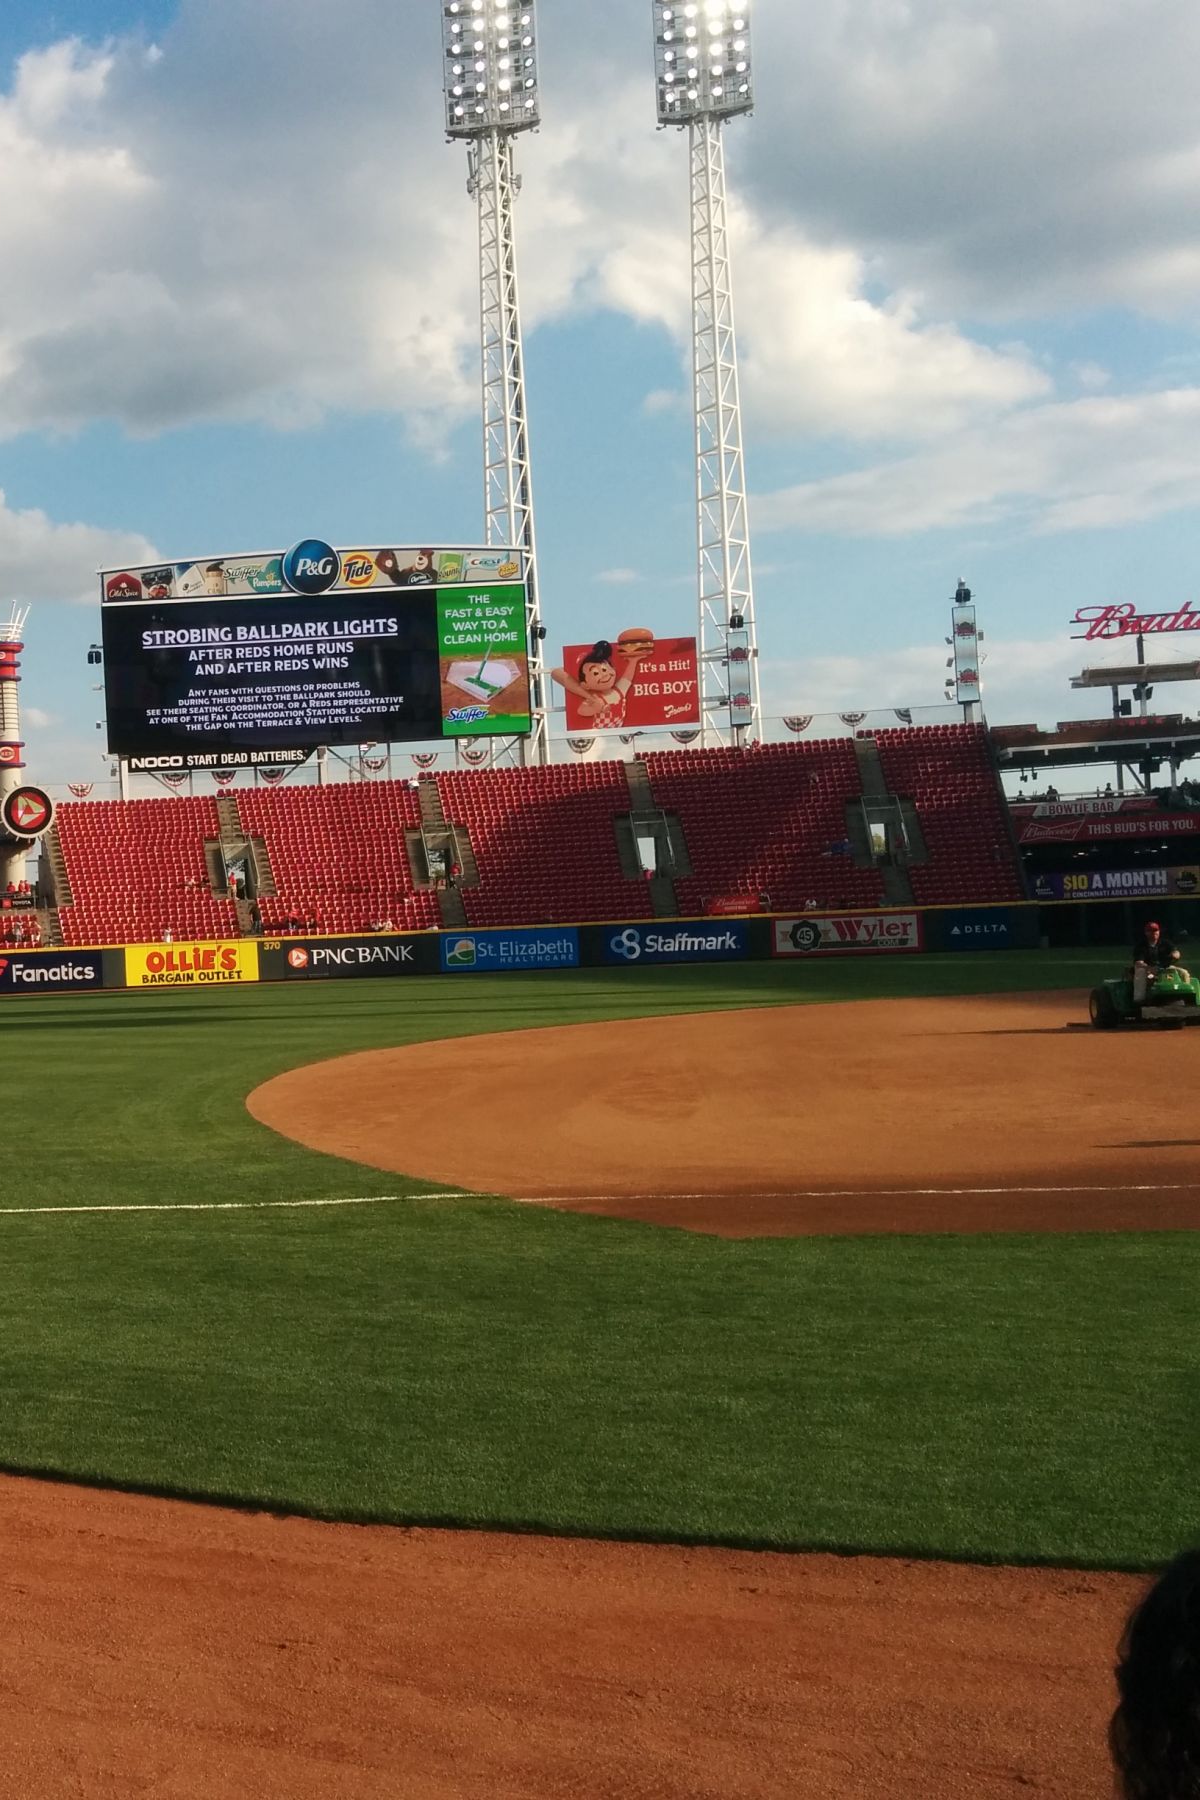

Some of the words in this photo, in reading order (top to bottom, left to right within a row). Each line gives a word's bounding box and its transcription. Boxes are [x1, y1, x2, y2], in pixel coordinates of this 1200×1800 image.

[223, 567, 261, 582] Swiffer
[295, 558, 333, 577] P&G
[344, 561, 373, 582] Tide
[252, 578, 282, 588] Pampers
[468, 594, 490, 604] THE
[445, 608, 473, 619] FAST
[474, 607, 483, 617] &
[485, 606, 514, 617] EASY
[142, 627, 233, 646] STROBING
[236, 621, 329, 641] BALLPARK
[333, 618, 398, 635] LIGHTS
[452, 621, 479, 632] WAY
[481, 620, 497, 630] TO
[499, 619, 509, 629] A
[444, 634, 481, 645] CLEAN
[484, 632, 518, 642] HOME
[189, 649, 232, 662] AFTER
[236, 646, 271, 659] REDS
[273, 644, 313, 657] HOME
[318, 642, 354, 654] RUNS
[195, 663, 224, 676] AND
[228, 661, 271, 674] AFTER
[274, 659, 309, 672] REDS
[312, 657, 349, 670] WINS
[639, 662, 657, 673] It's
[659, 664, 666, 672] a
[668, 659, 690, 671] Hit!
[208, 688, 230, 696] FANS
[231, 687, 254, 695] WITH
[255, 685, 301, 694] QUESTIONS
[316, 681, 360, 690] PROBLEMS
[634, 683, 660, 697] BIG
[662, 680, 693, 695] BOY
[163, 707, 188, 715] THEIR
[189, 705, 224, 714] SEATING
[333, 696, 404, 706] REPRESENTATIVE
[178, 698, 210, 706] DURING
[211, 696, 236, 704] THEIR
[238, 695, 259, 703] VISIT
[274, 693, 291, 701] THE
[293, 691, 335, 700] BALLPARK
[337, 690, 370, 698] SHOULD
[161, 716, 178, 724] ONE
[180, 715, 191, 723] OF
[350, 706, 388, 714] LOCATED
[446, 706, 490, 723] Swiffer
[223, 721, 236, 729] ON
[295, 717, 302, 726] &
[131, 756, 183, 769] NOCO
[187, 753, 219, 766] START
[221, 752, 247, 764] DEAD
[250, 749, 307, 763] BATTERIES.
[1049, 802, 1090, 815] BOWTIE
[1092, 801, 1115, 813] BAR
[1088, 824, 1112, 835] THIS
[1115, 822, 1147, 834] BUD'S
[1150, 821, 1170, 831] FOR
[1172, 819, 1197, 830] YOU.
[1063, 873, 1088, 891] $10
[1092, 873, 1103, 889] A
[1106, 870, 1168, 888] MONTH
[1072, 890, 1109, 898] CINCINNATI
[799, 929, 812, 941] 45
[831, 919, 913, 944] Wyler
[964, 923, 1008, 934] DELTA
[263, 941, 281, 950] 370
[478, 942, 497, 957] St.
[500, 939, 574, 956] Elizabeth
[644, 931, 737, 953] Staffmark
[500, 954, 575, 963] HEALTHCARE
[12, 962, 95, 984] Fanatics
[142, 972, 194, 984] BARGAIN
[198, 970, 242, 982] OUTLET
